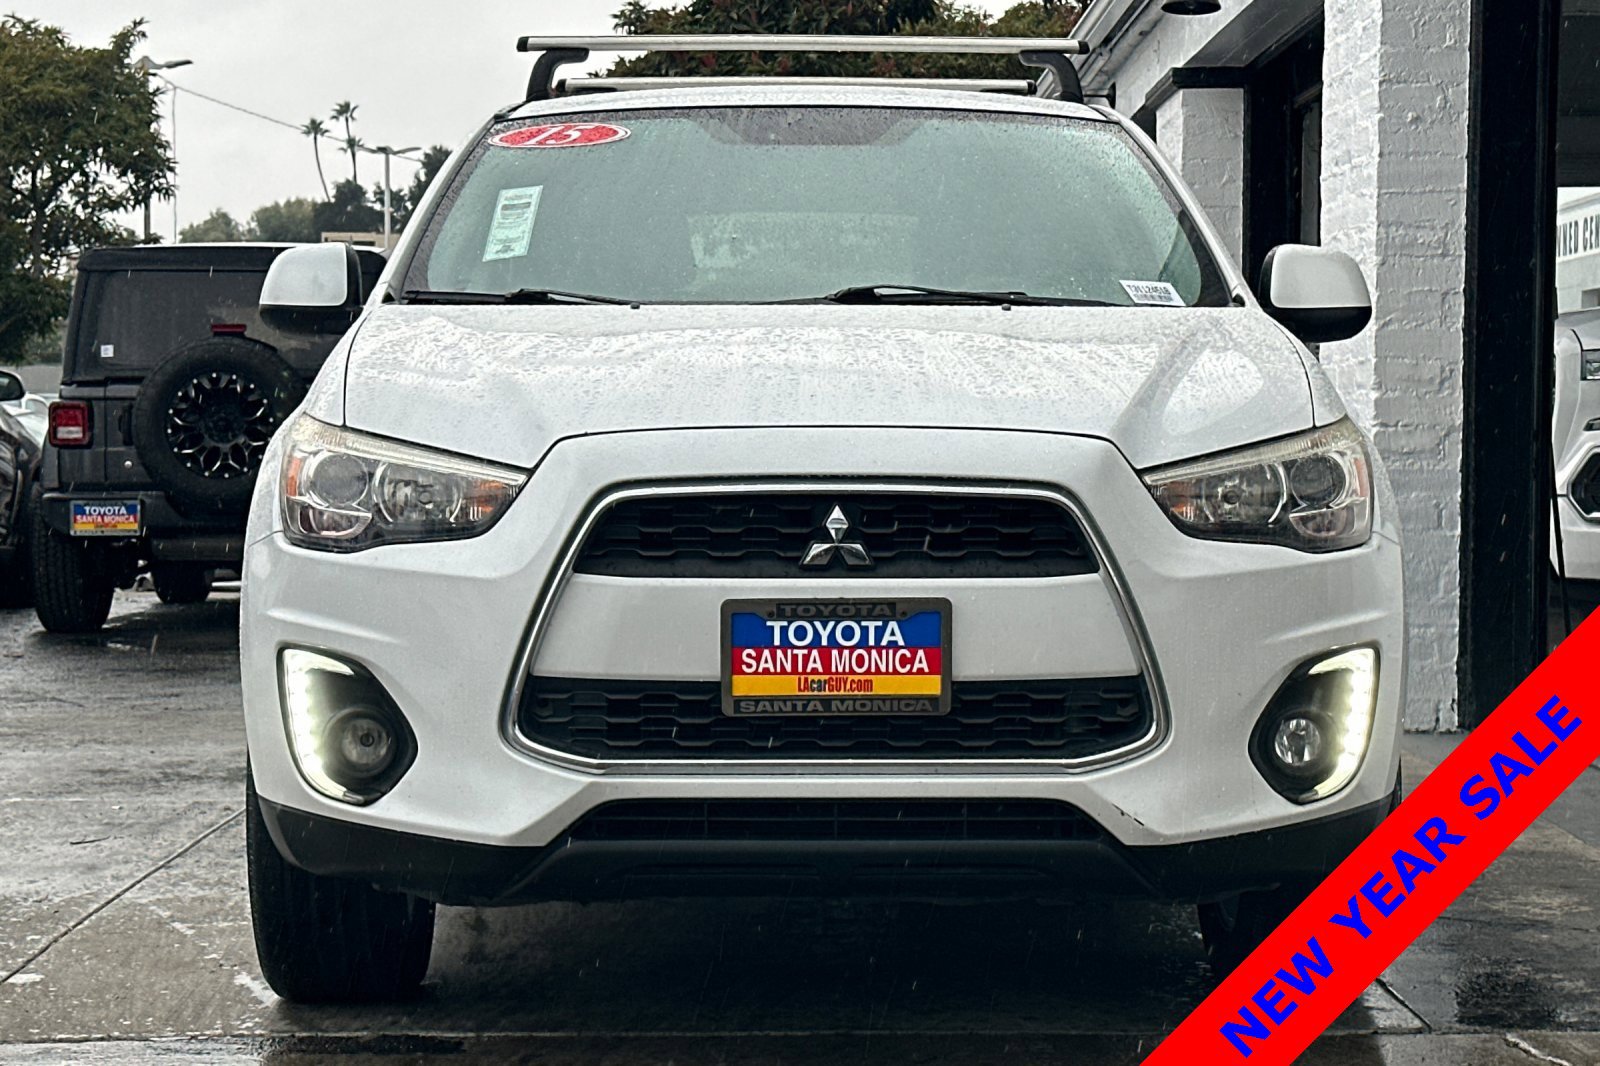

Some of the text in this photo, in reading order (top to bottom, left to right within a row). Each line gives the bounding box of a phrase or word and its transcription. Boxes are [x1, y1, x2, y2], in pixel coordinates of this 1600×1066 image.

[523, 125, 598, 145] 15
[84, 506, 127, 516] TOYOTA
[76, 515, 135, 523] SANTA MONICA
[779, 604, 893, 618] TOYOTA
[766, 620, 905, 647] TOYOTA
[741, 648, 929, 674] SANTA MONICA
[797, 676, 873, 693] LAcarGUY.com
[739, 699, 933, 713] SANTA MONICA
